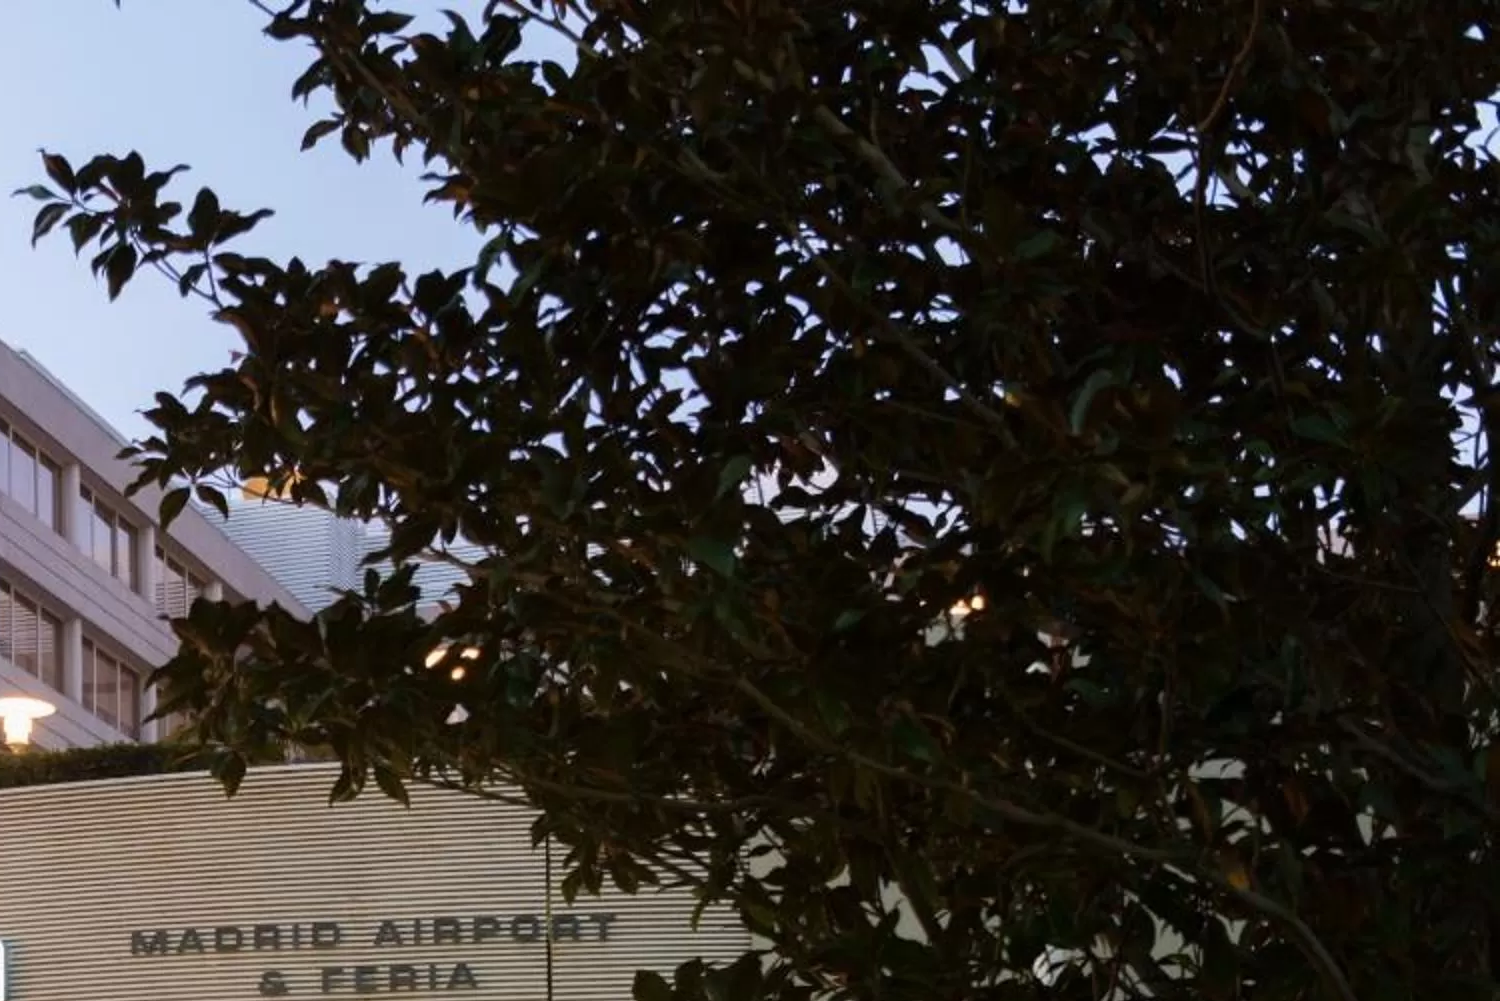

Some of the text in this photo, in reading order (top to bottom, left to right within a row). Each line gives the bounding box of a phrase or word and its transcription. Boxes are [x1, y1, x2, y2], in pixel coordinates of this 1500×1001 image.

[131, 913, 616, 956] MADRID AIRPORT
[258, 963, 478, 998] & FERIA
